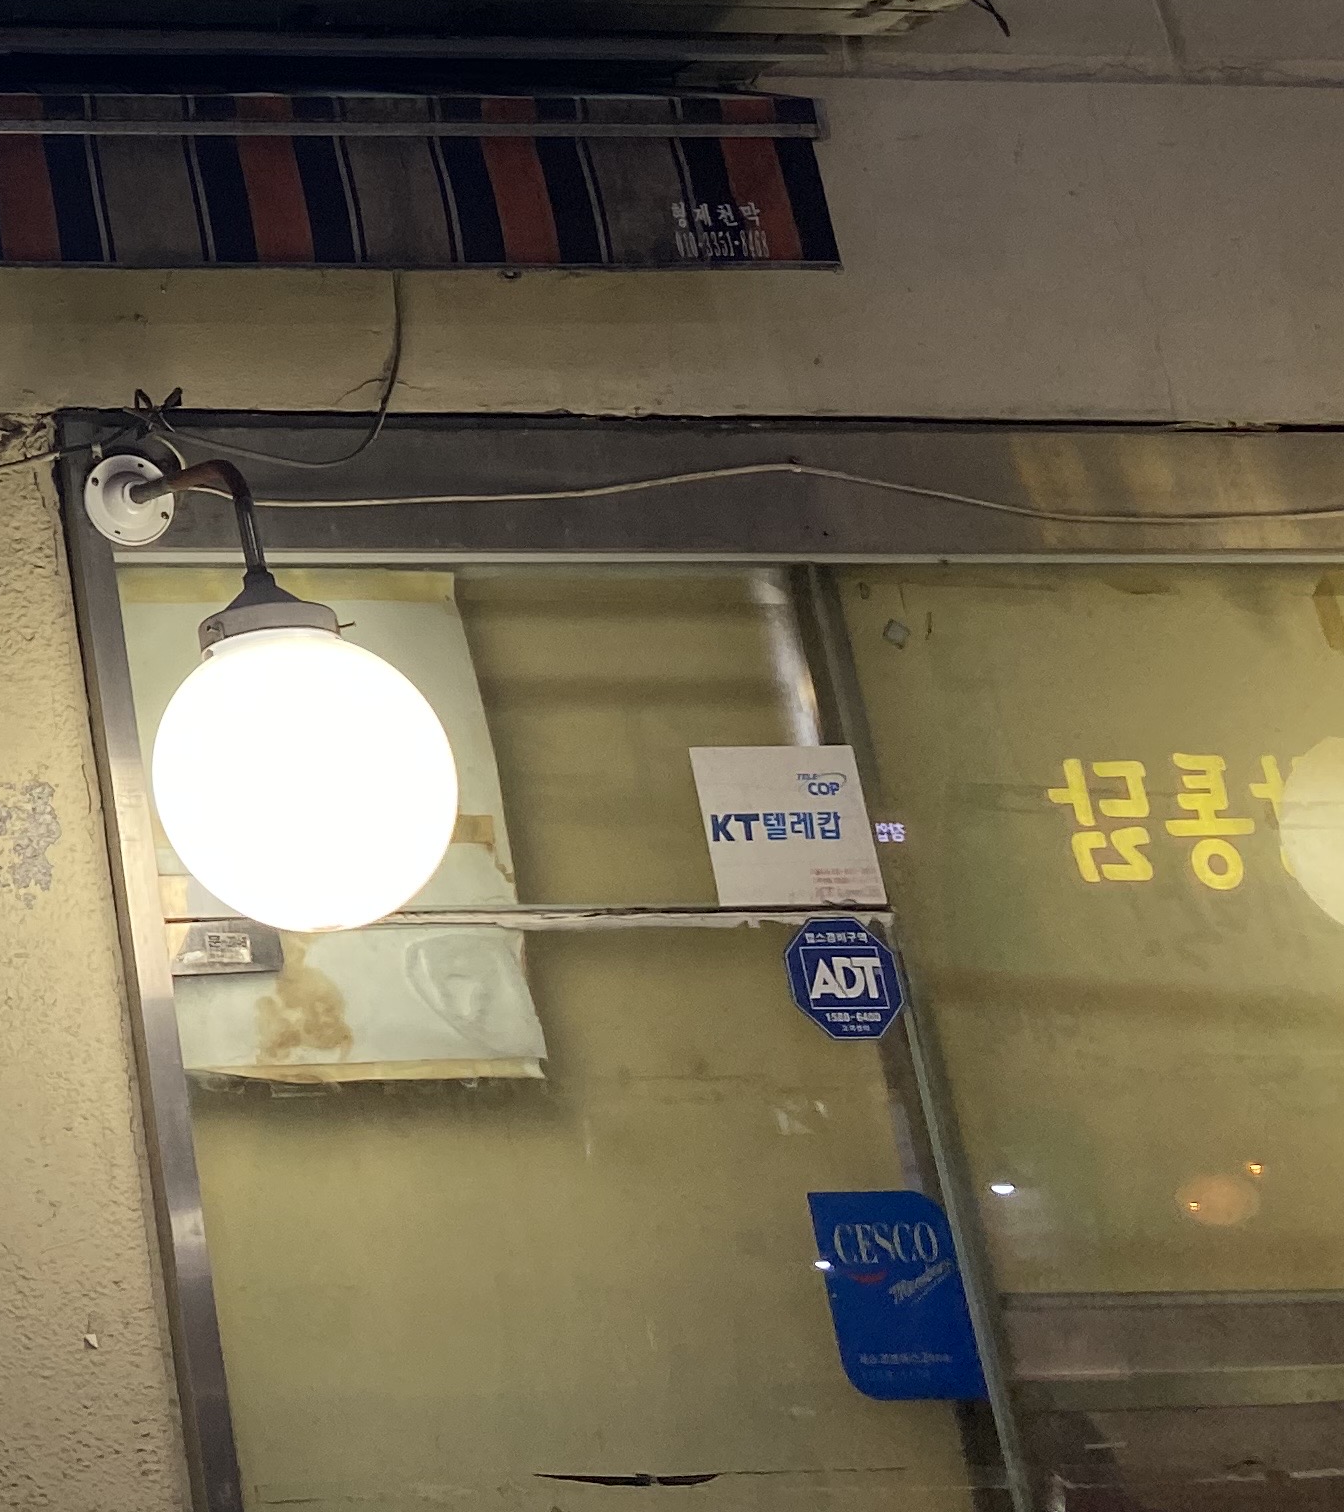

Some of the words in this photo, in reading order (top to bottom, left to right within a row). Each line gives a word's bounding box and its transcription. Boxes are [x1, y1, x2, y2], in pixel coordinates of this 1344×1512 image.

[710, 811, 842, 842] KT텔레캅
[810, 956, 882, 1000] ADT
[833, 1221, 940, 1264] CESCO
